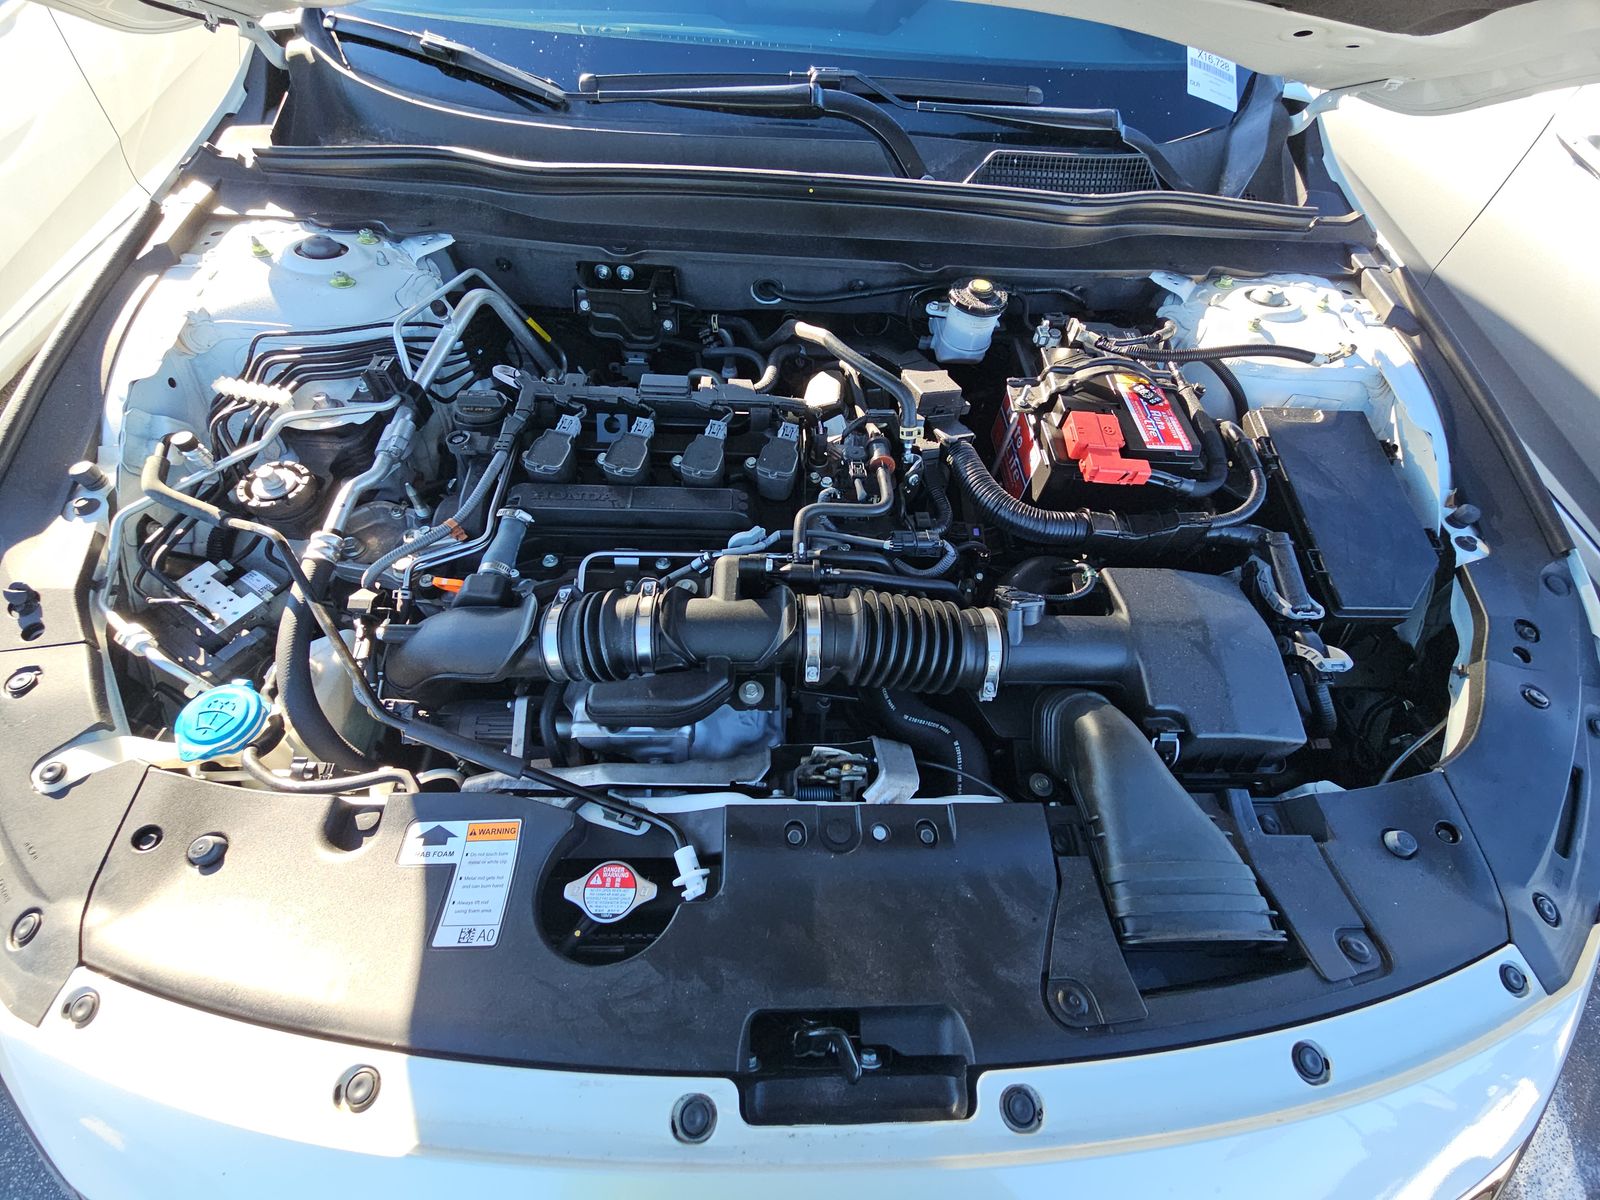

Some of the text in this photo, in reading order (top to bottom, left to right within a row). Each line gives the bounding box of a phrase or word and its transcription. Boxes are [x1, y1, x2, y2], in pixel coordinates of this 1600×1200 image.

[1150, 409, 1166, 430] Auto
[478, 827, 517, 836] WARNING
[432, 850, 455, 858] FOAM
